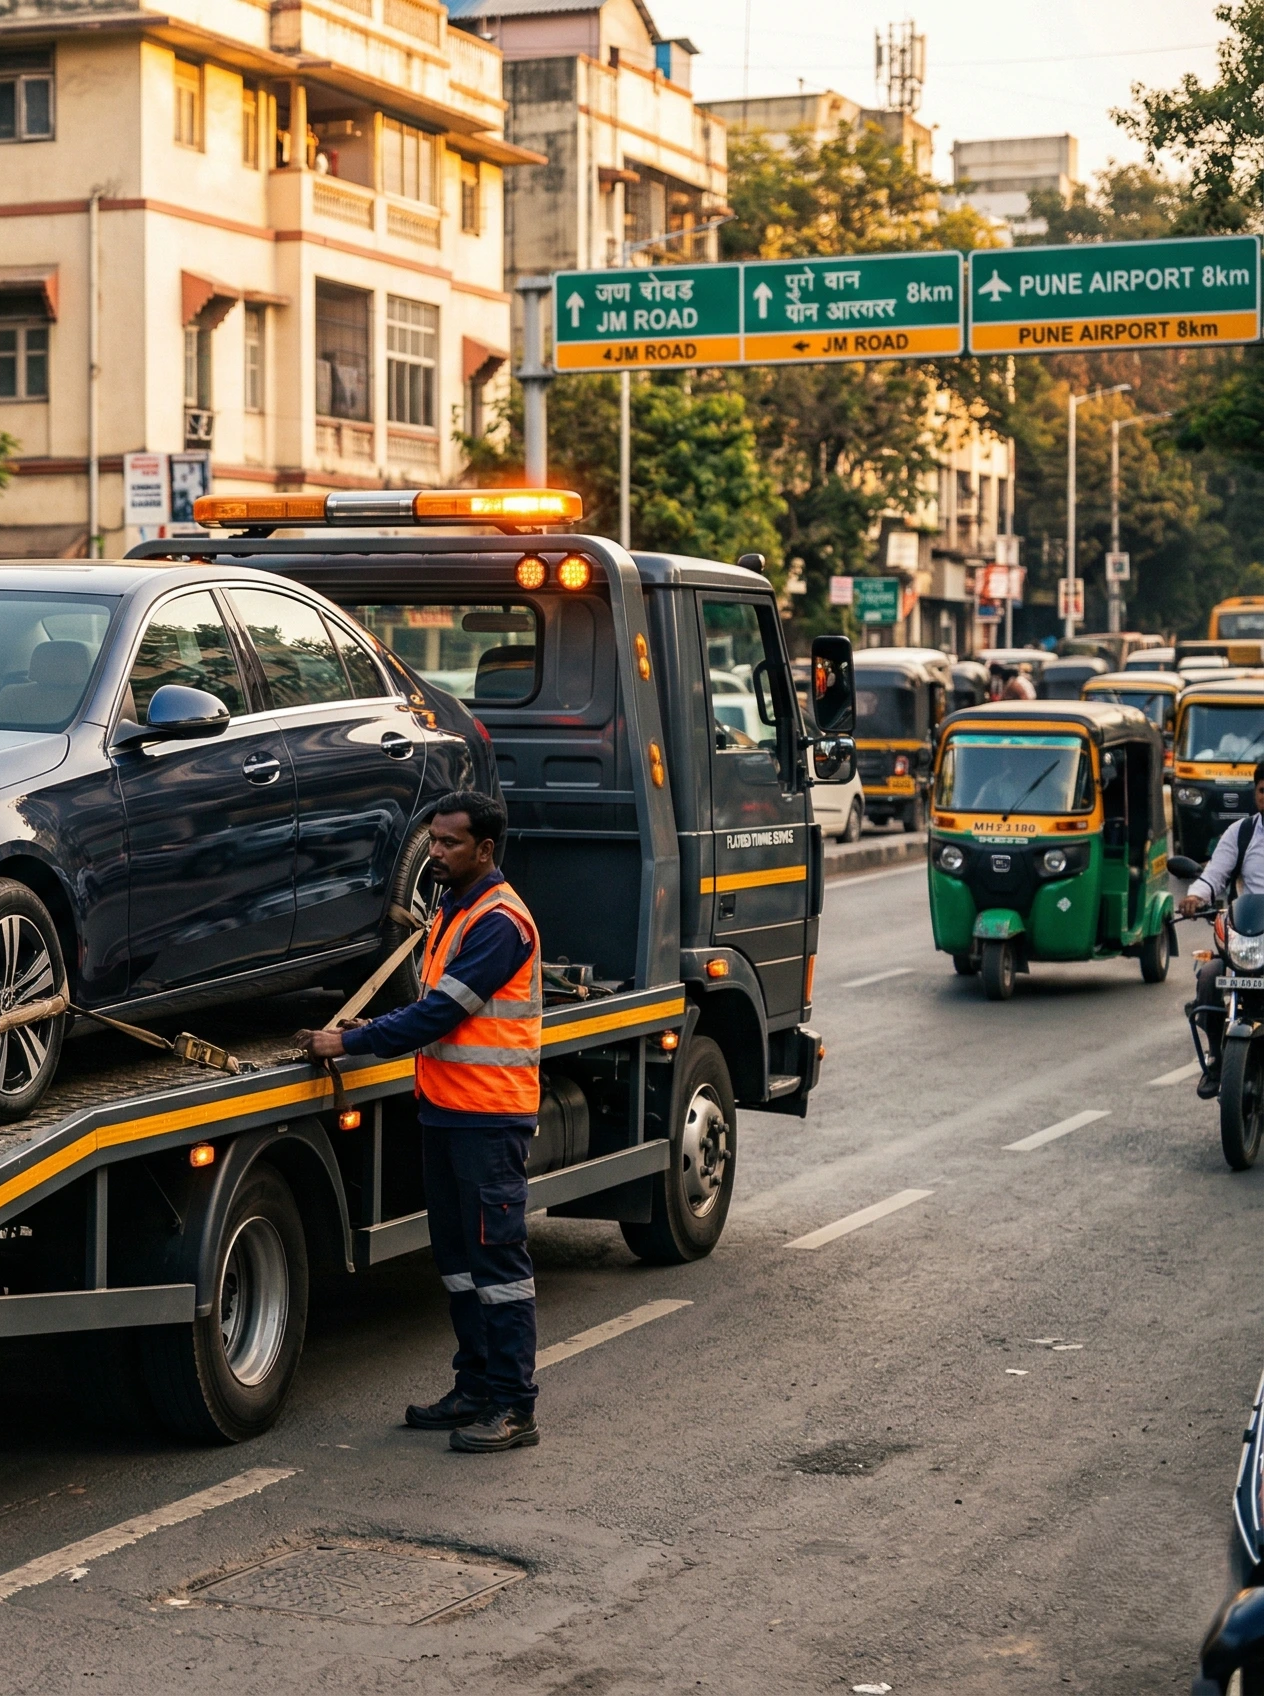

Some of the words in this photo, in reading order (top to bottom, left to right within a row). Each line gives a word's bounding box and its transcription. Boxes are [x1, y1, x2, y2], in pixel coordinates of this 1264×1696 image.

[1020, 272, 1083, 297] PUNE
[1089, 266, 1195, 293] AIRPORT
[1201, 264, 1250, 288] 8km
[906, 281, 953, 304] 8km
[596, 310, 627, 333] JM
[633, 307, 699, 330] ROAD
[822, 335, 848, 353] JM
[854, 333, 909, 351] ROAD
[1019, 327, 1074, 344] PUNE
[1079, 321, 1171, 341] AIRPORT
[1176, 321, 1219, 338] 8km
[645, 342, 698, 360] ROAD
